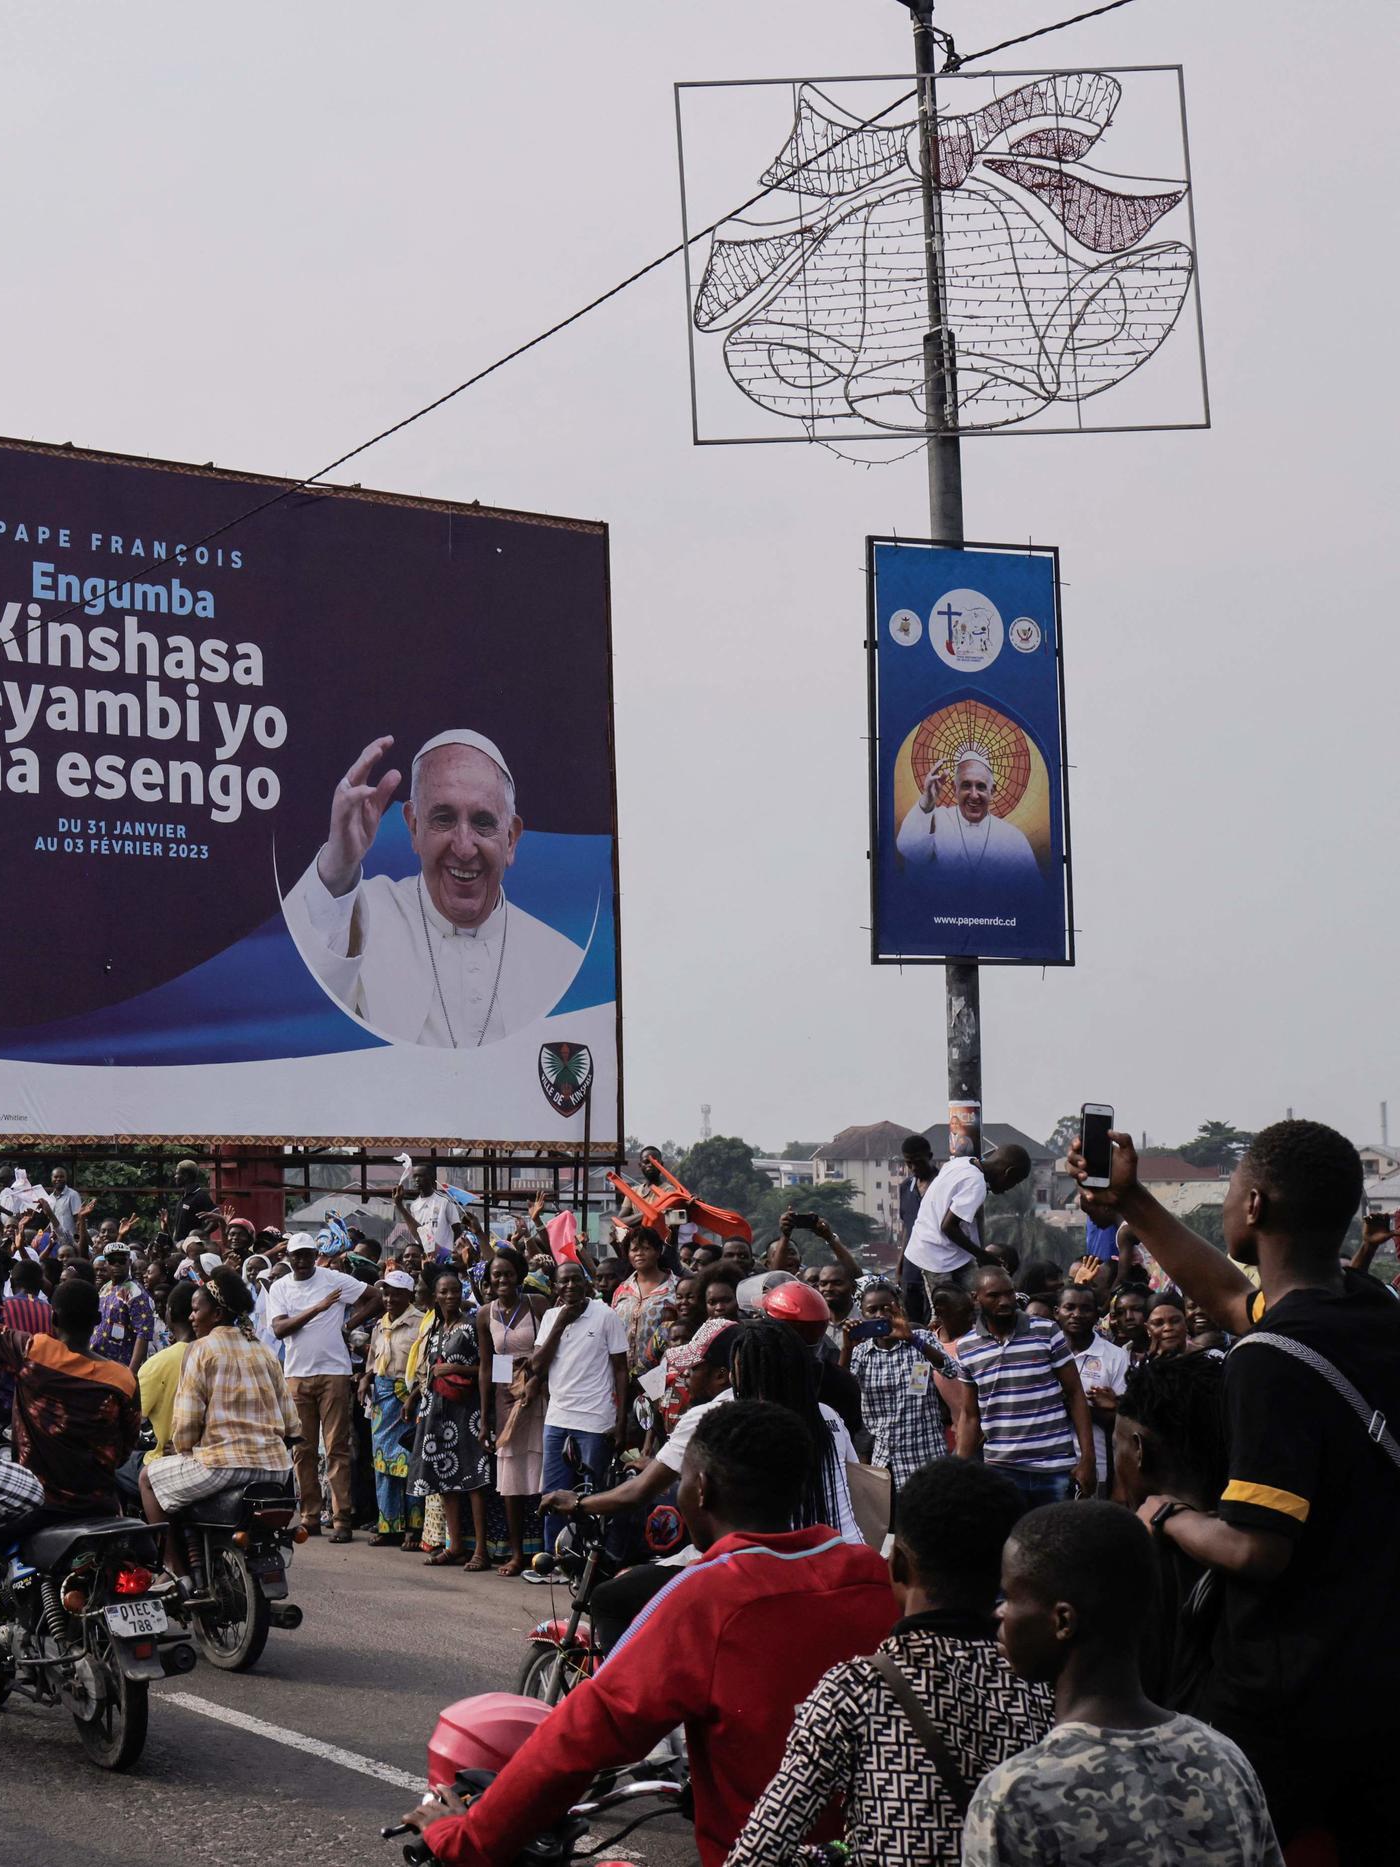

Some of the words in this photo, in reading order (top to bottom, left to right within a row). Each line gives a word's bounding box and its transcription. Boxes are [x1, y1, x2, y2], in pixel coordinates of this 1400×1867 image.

[91, 533, 243, 569] FRANÇOIS
[32, 561, 215, 618] Engumba
[213, 701, 288, 761] yo
[56, 752, 281, 823] esengo
[58, 818, 82, 833] DU
[87, 820, 107, 835] 31
[113, 820, 187, 839] JANVIER
[35, 836, 58, 852] AU
[64, 838, 84, 854] 03
[90, 837, 163, 857] FÉVRIER
[168, 843, 209, 859] 2023
[933, 916, 1017, 927] www.papeenrdc.cd
[540, 1073, 555, 1097] VILLE
[553, 1092, 565, 1106] DE
[129, 1619, 153, 1633] 788
